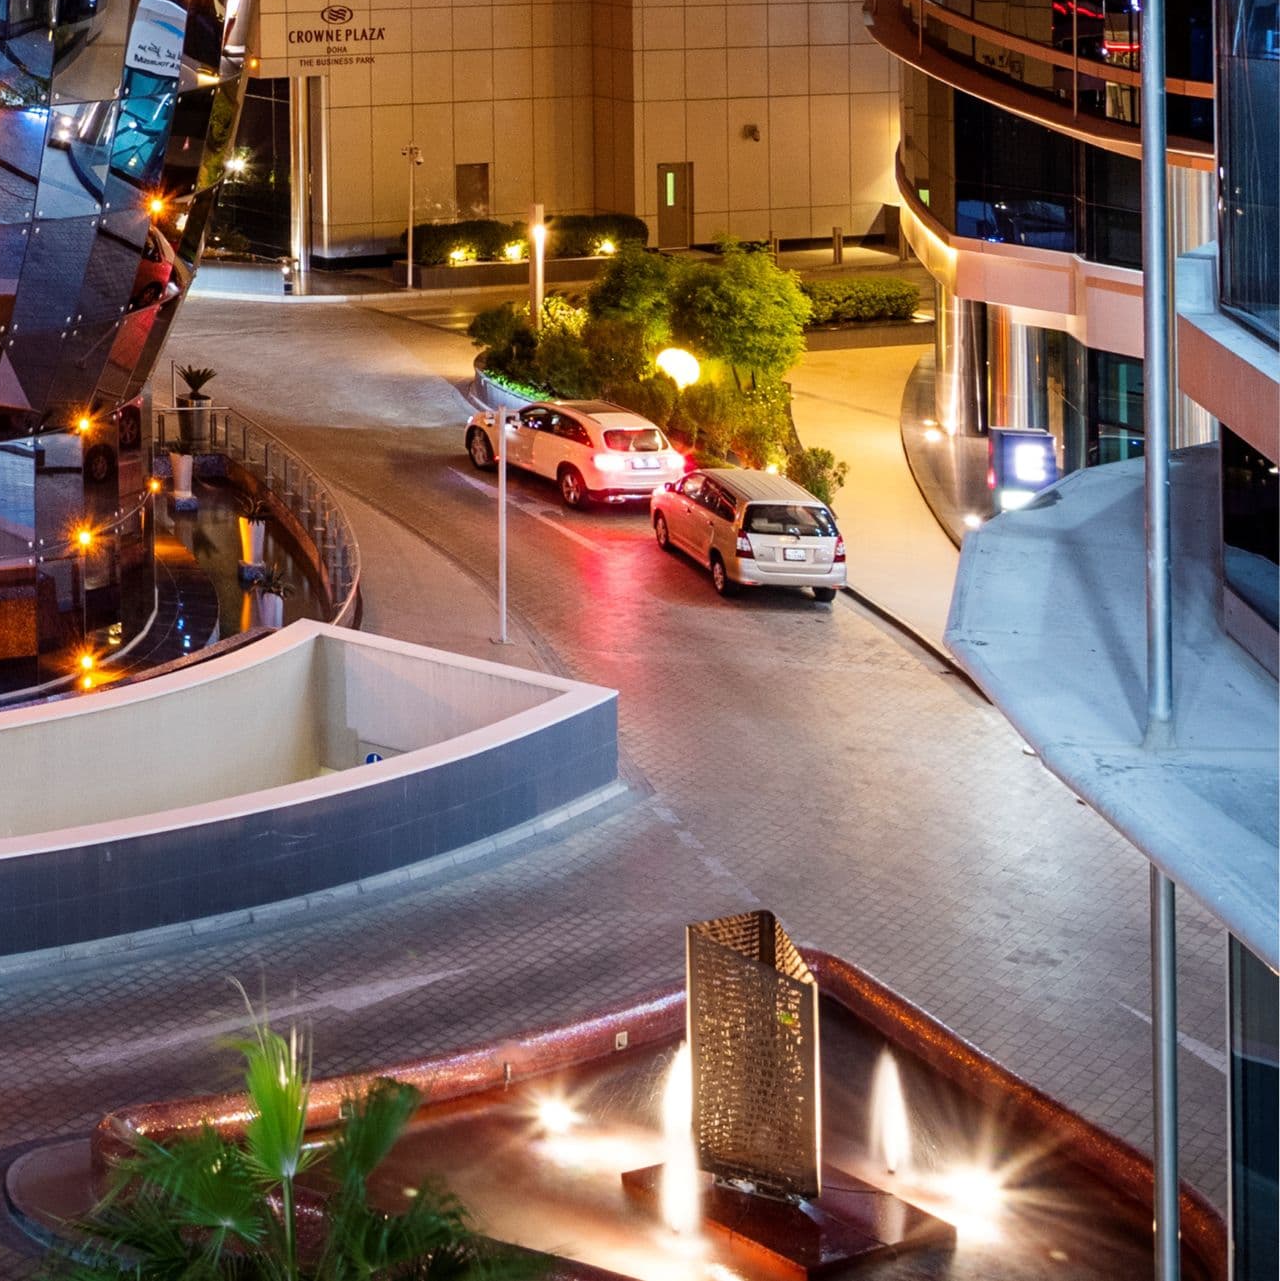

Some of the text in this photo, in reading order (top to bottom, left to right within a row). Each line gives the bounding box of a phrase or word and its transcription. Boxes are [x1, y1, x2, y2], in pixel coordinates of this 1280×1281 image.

[288, 27, 385, 44] CROWNE PLAZA
[326, 46, 347, 54] DOHA
[299, 56, 376, 67] THE BUSINESS PARK
